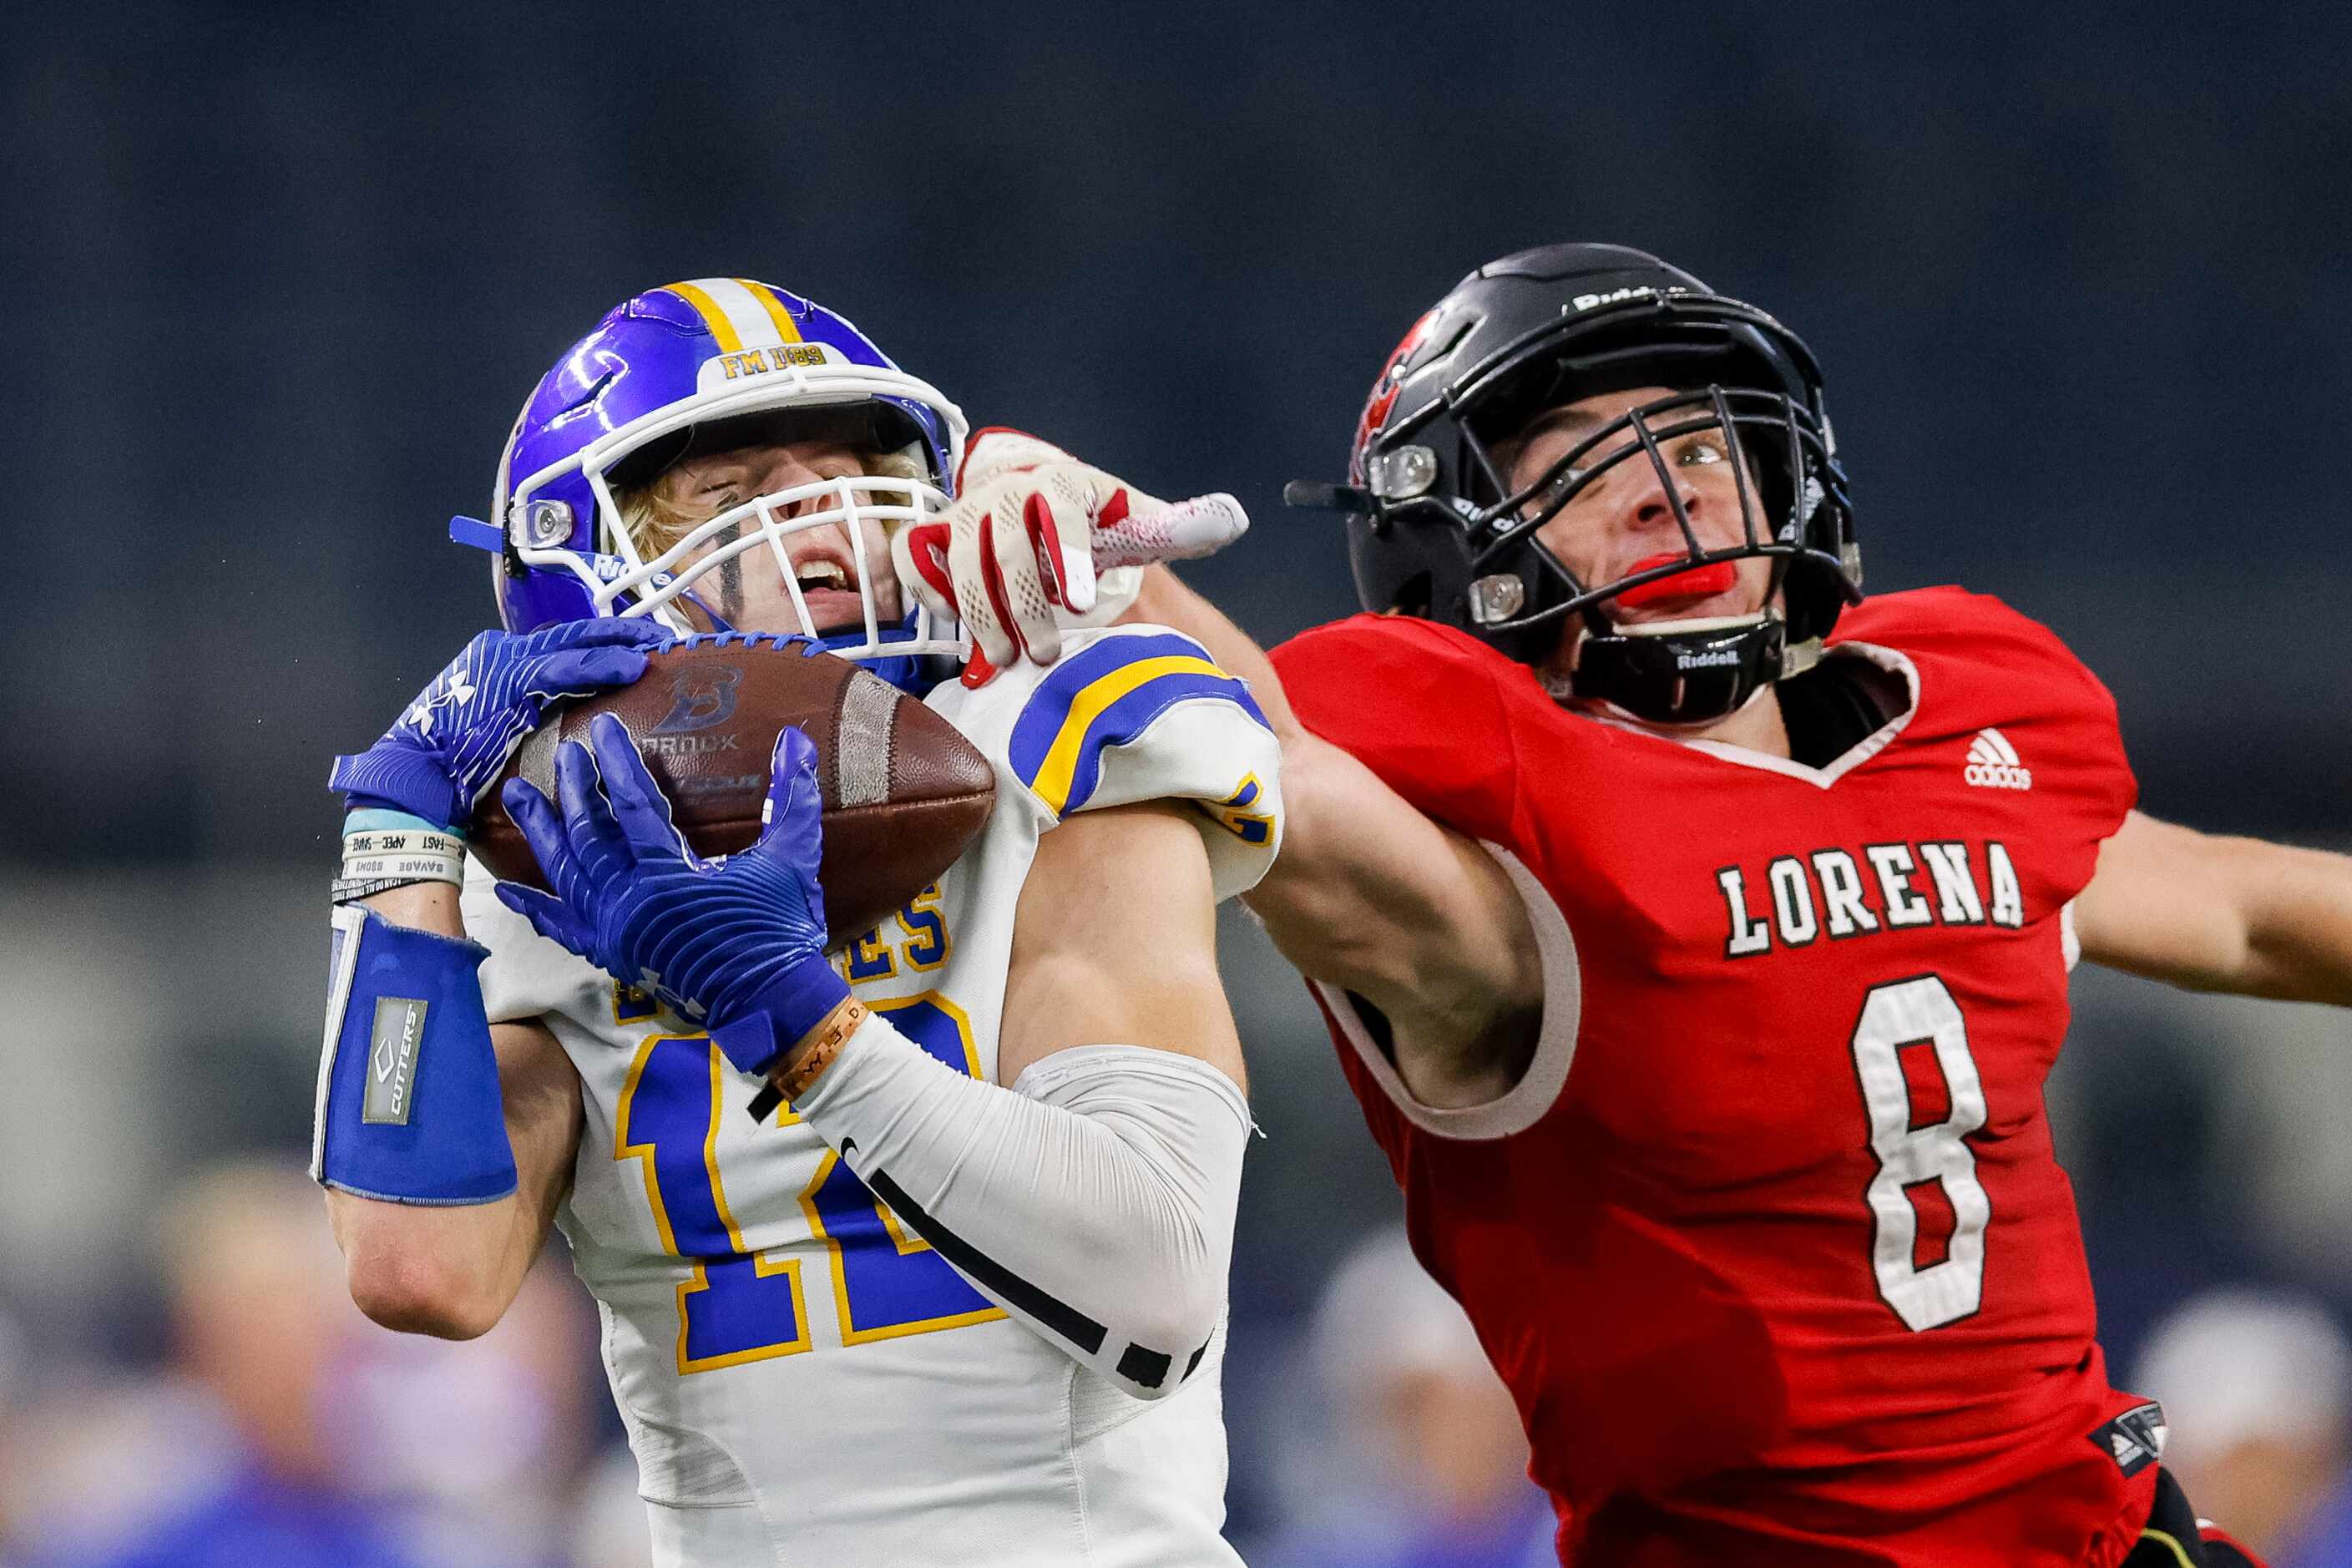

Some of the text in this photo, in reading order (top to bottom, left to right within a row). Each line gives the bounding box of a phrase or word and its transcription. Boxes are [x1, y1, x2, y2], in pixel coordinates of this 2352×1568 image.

[720, 349, 768, 380] FM
[1677, 650, 1738, 670] Riddell
[1964, 764, 2032, 792] adidas
[422, 836, 445, 851] FAST
[1716, 840, 2026, 960] LORENA
[391, 1009, 417, 1116] CUTTERS
[1848, 971, 1992, 1333] 8
